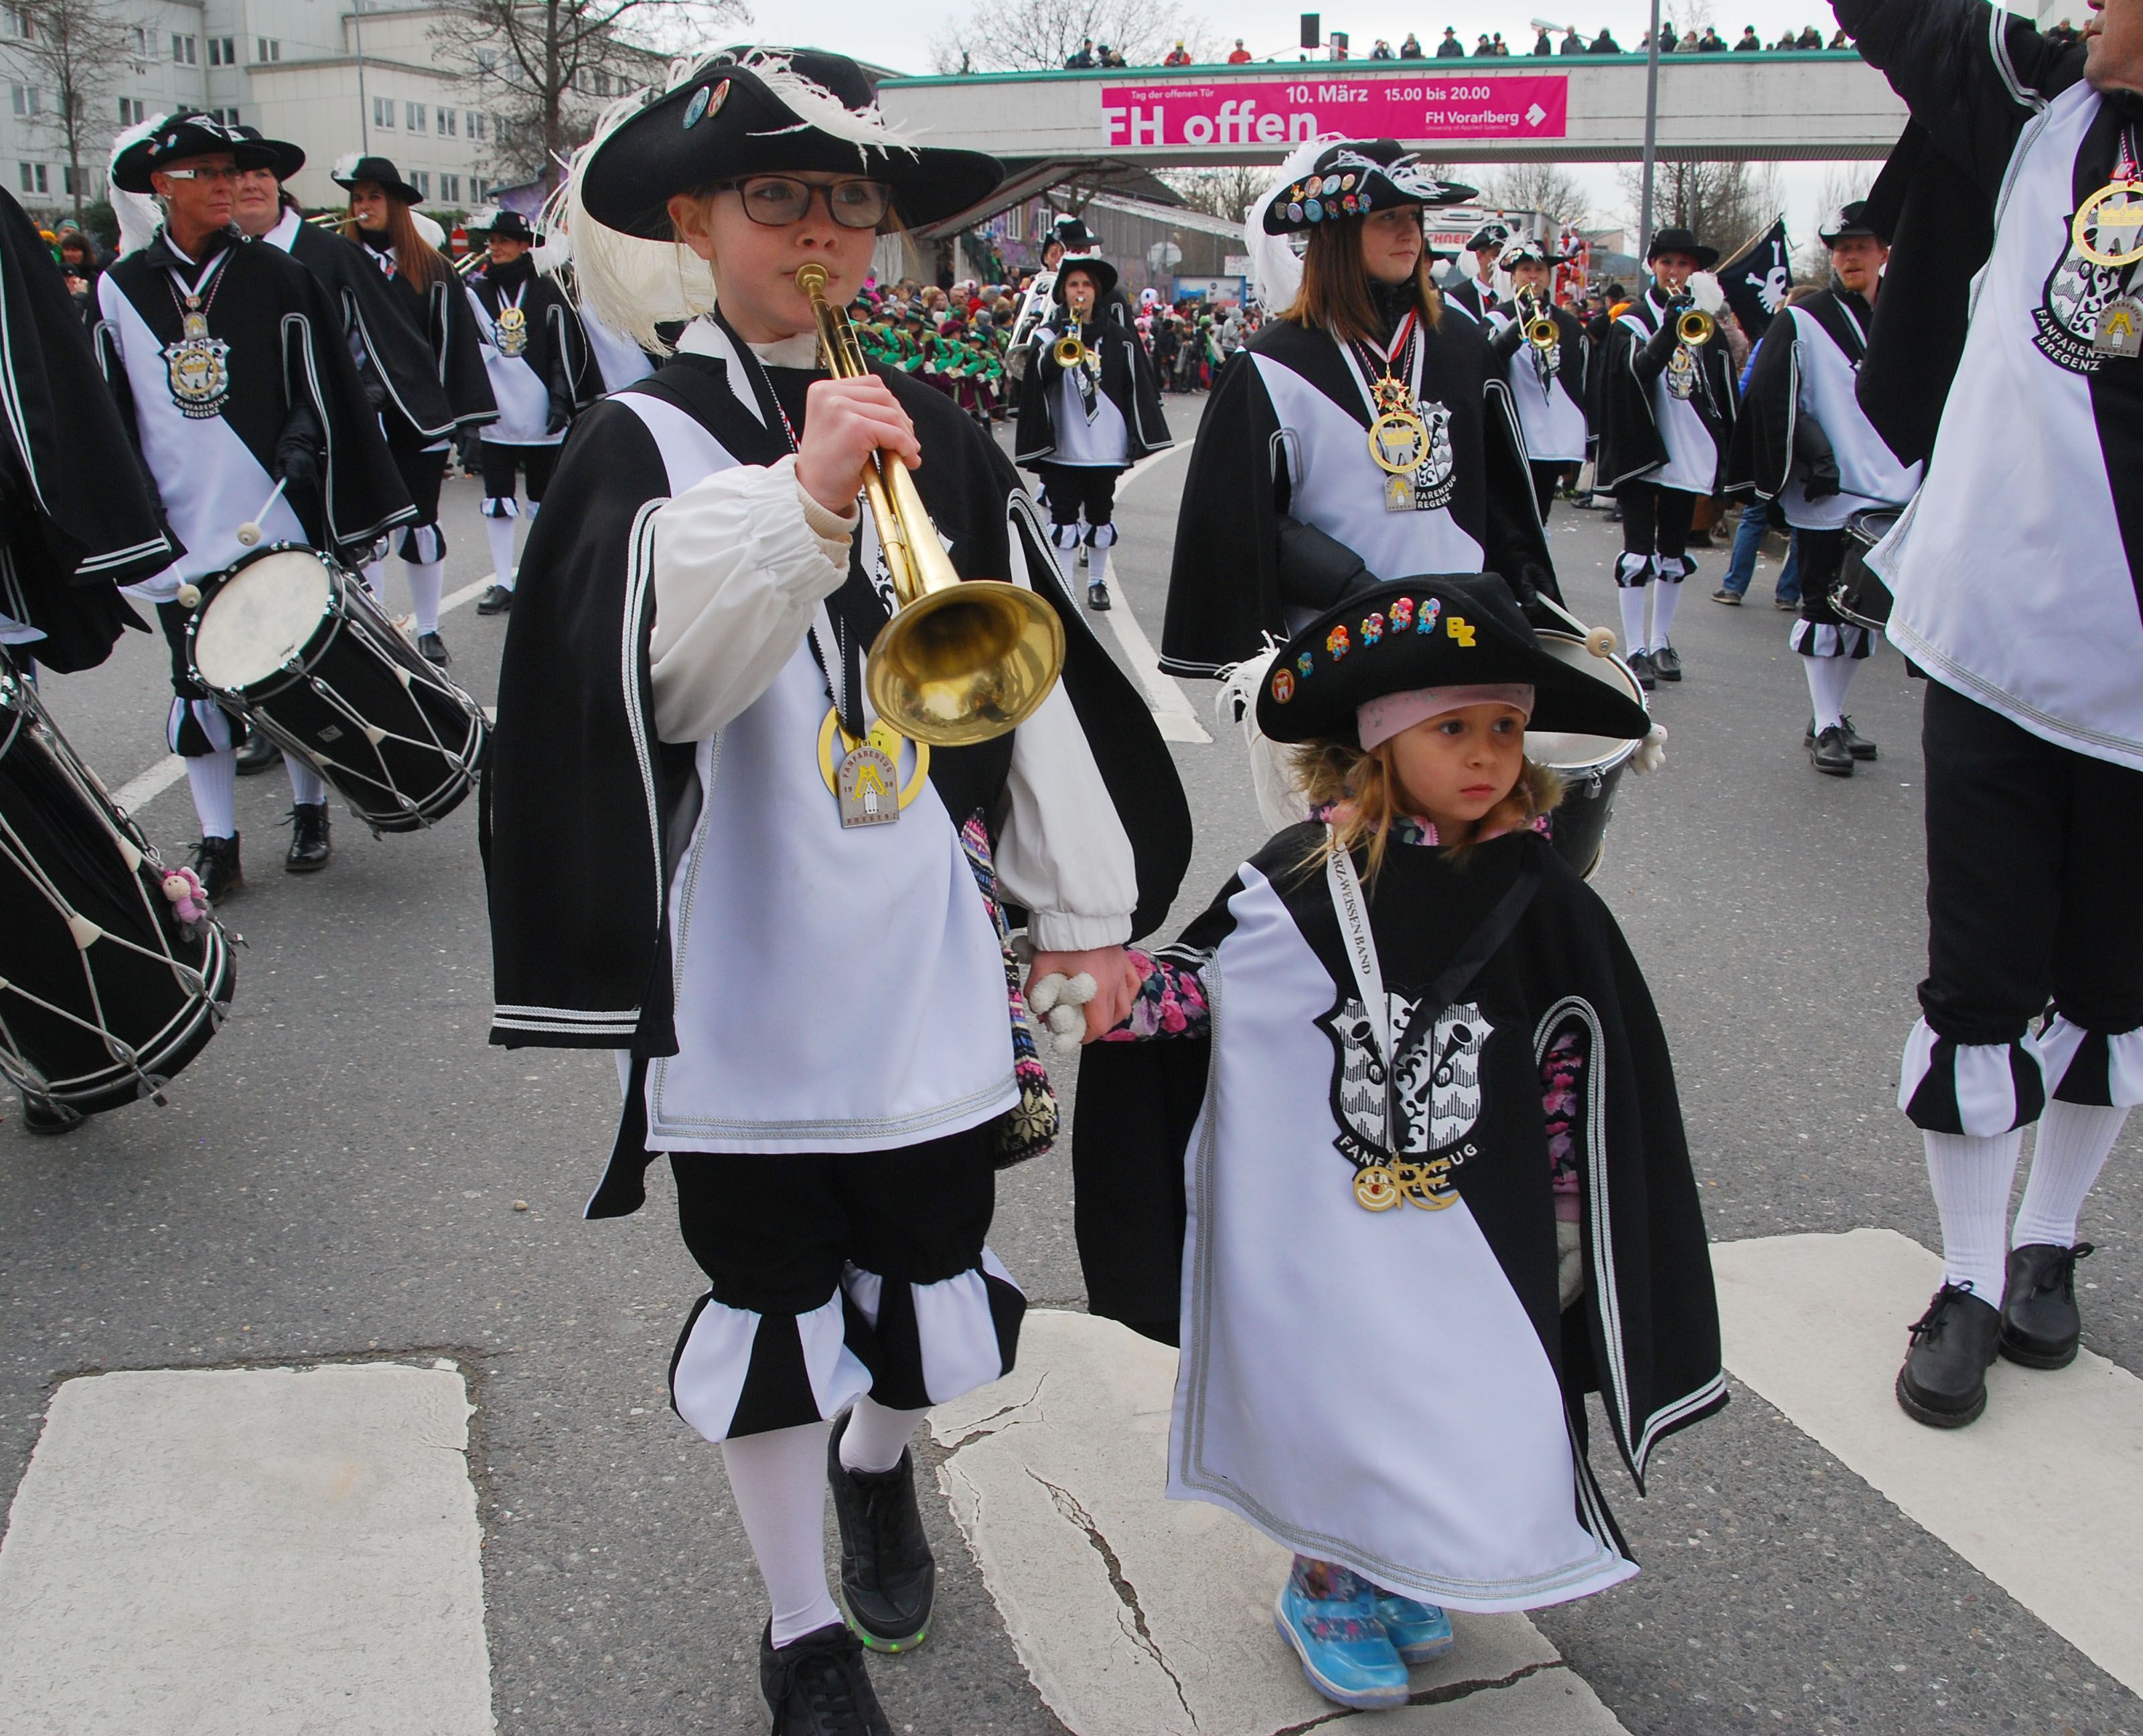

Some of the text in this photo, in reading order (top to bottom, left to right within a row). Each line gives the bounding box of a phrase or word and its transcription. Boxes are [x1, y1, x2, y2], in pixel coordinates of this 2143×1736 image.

[1131, 88, 1214, 100] Tag der offenen Tür
[1286, 84, 1368, 103] 10. März
[1384, 86, 1490, 102] 15.00 bis 20.00
[1102, 100, 1317, 146] FH offen
[1425, 110, 1520, 126] FH Vorarlberg
[2037, 336, 2100, 371] BREGENZ
[174, 394, 230, 411] FANFARENZUG
[185, 407, 220, 418] BREGENZ
[1416, 475, 1457, 500] FARENZUG
[1416, 492, 1452, 509] REGENZ
[842, 750, 893, 778] FANFARENZUG
[1331, 850, 1371, 975] ARZ-WEISSEN BAND
